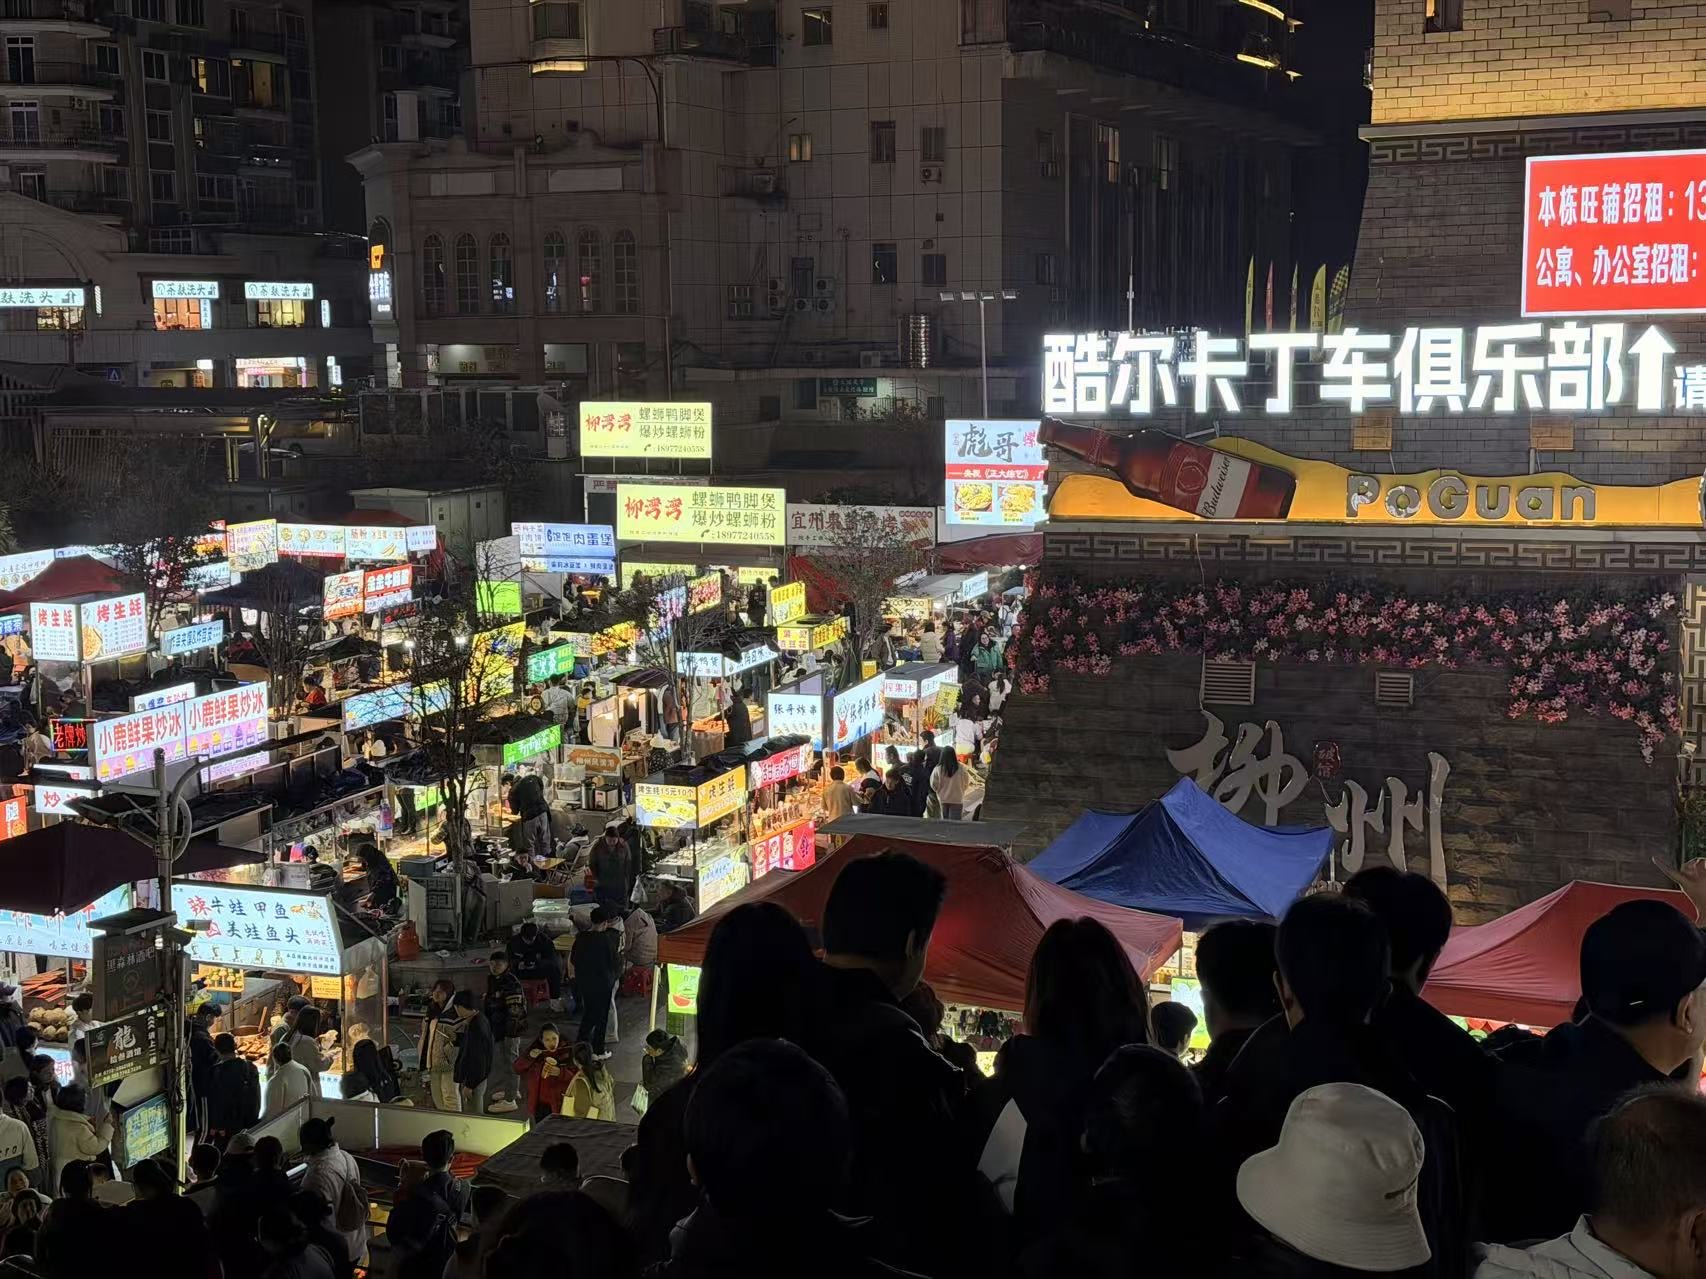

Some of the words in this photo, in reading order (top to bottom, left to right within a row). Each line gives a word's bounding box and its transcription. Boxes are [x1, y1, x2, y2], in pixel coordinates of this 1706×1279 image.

[1043, 322, 1626, 413] 酷尔卡丁车俱乐部
[1201, 455, 1232, 517] Budweiser
[1346, 475, 1596, 520] PoGuan
[38, 608, 73, 627] 烤生蚝
[97, 598, 142, 622] 烤生蚝
[189, 688, 264, 730] 小鹿鲜果炒冰
[99, 711, 182, 755] 小鹿鲜果炒冰
